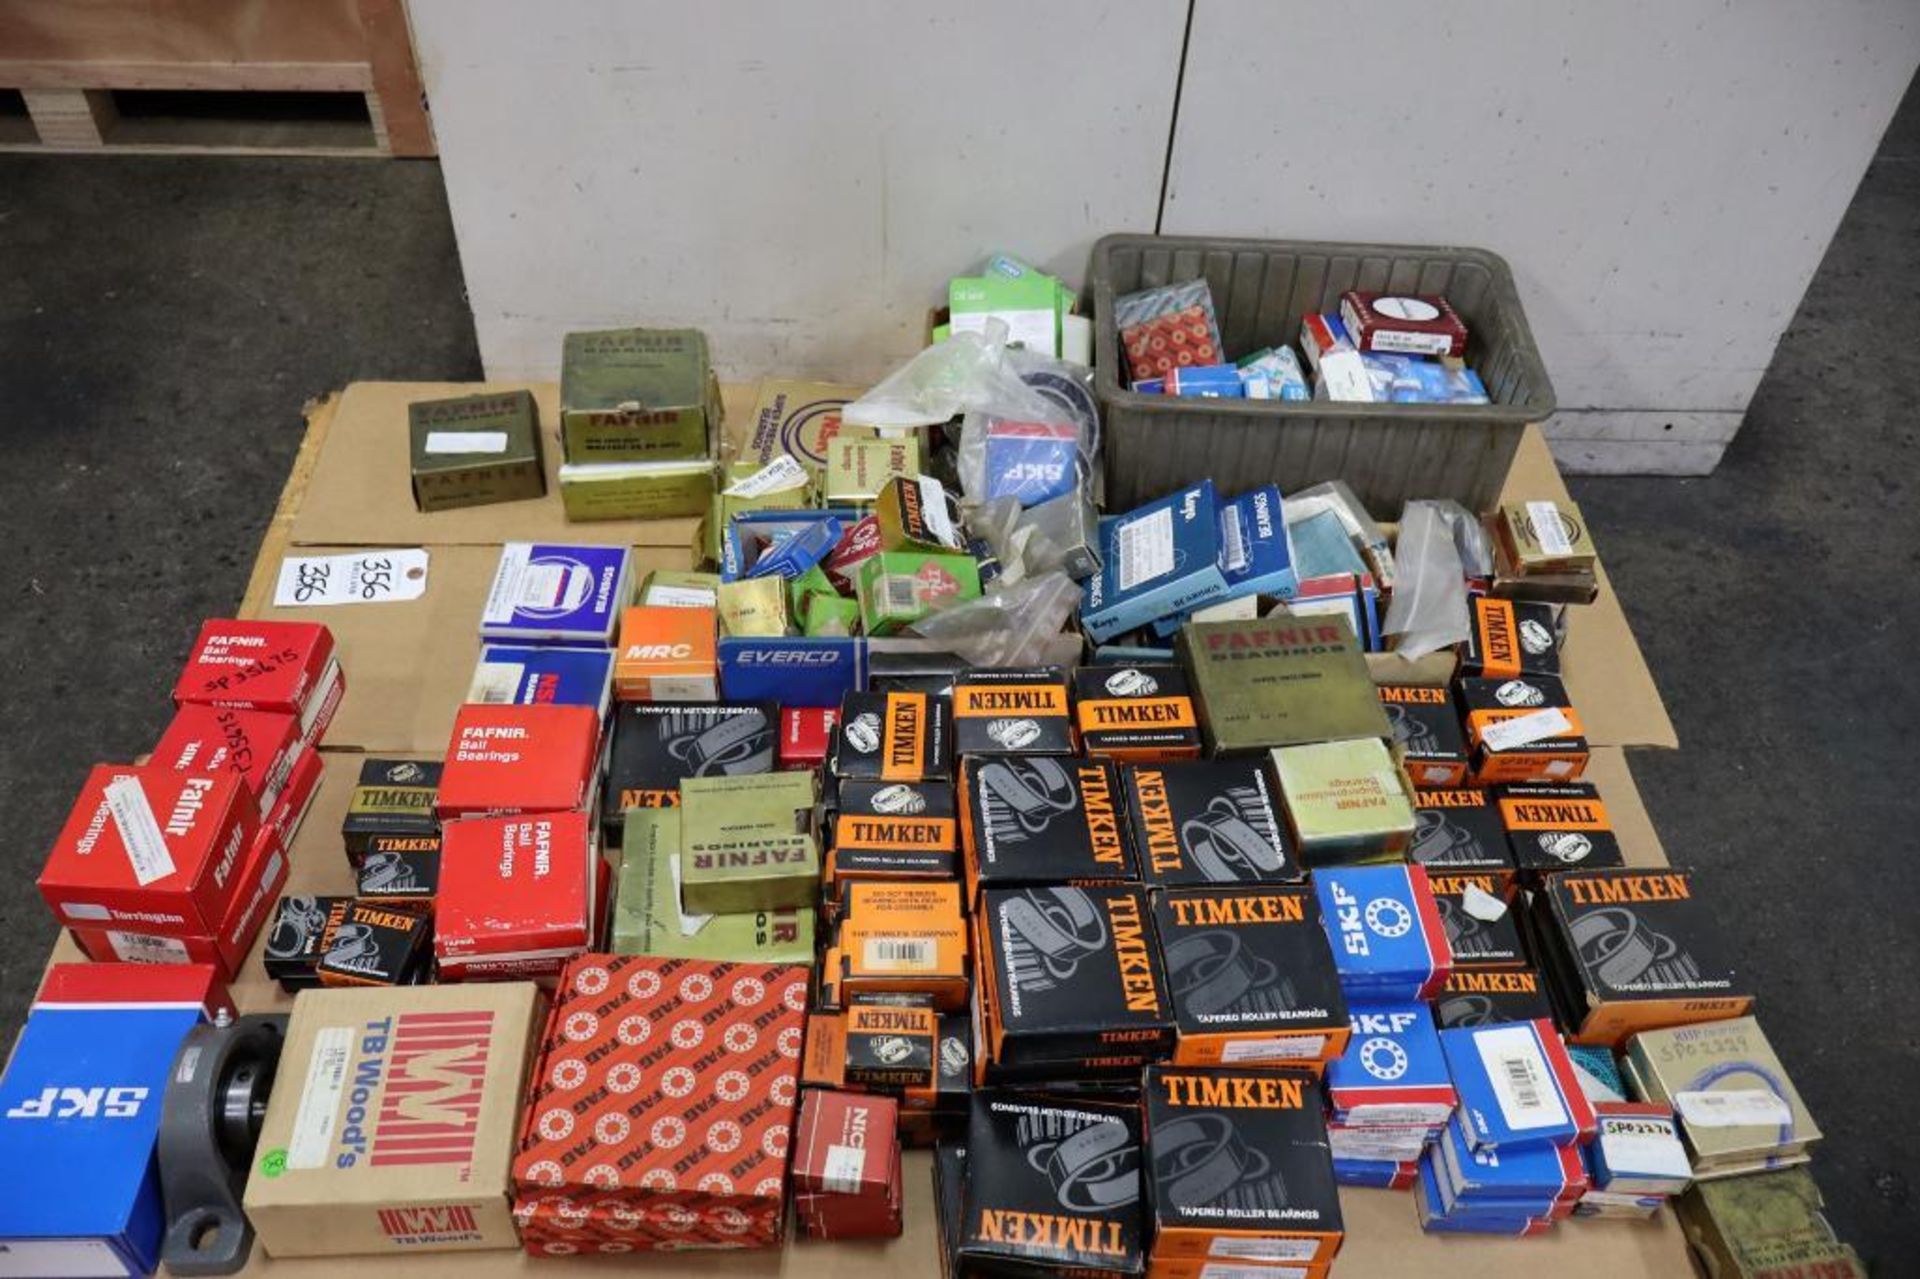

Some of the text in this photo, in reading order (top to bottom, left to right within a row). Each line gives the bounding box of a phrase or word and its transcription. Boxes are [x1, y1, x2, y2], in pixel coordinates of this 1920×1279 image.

[760, 421, 779, 463] PRECISIO
[1004, 463, 1064, 481] SKF
[904, 481, 922, 538] TIMKEN
[296, 563, 330, 601] 356
[362, 558, 392, 599] 356
[208, 636, 266, 648] FAFNIR
[1207, 626, 1340, 649] FAFNIR
[1485, 606, 1512, 663] TIMKEN
[625, 644, 692, 659] MRC
[737, 651, 840, 663] EVERCO
[536, 674, 559, 705] NS
[969, 691, 1056, 710] TIMKEN
[1377, 687, 1446, 704] IMKEN
[1093, 703, 1181, 724] TIMKEN
[460, 740, 487, 750] Ball
[462, 727, 527, 739] FAFNIR
[892, 701, 917, 767] TIMKEN
[457, 751, 520, 762] Bearings
[165, 778, 214, 836] Fafnir
[361, 790, 437, 808] TIMKEN
[620, 789, 681, 809] KEN
[1414, 791, 1485, 808] IMKEN
[1078, 765, 1124, 864] TIMKEN
[1134, 770, 1183, 874] TIMKEN
[1515, 804, 1598, 823] TIMKEN
[377, 838, 441, 851] TIMKEN
[520, 823, 533, 846] Ball
[852, 823, 942, 843] TIMKEN
[214, 823, 243, 889] Fafnir
[501, 823, 518, 878] Bearings
[535, 821, 551, 877] FAFNIR
[694, 850, 807, 869] FAFNIR
[1564, 874, 1691, 904] TIMKEN
[111, 909, 184, 924] Torrington
[352, 907, 416, 931] TIMKEN
[1169, 895, 1304, 926] TIMKEN
[1330, 881, 1370, 956] SKF
[1106, 894, 1160, 1012] TIMKEN
[1445, 972, 1538, 993] TIMKEN
[597, 992, 632, 1018] FAG
[649, 996, 683, 1022] FAG
[702, 999, 735, 1026] FAG
[755, 1003, 787, 1030] FAG
[1683, 1000, 1737, 1011] TIMKEN
[857, 1012, 928, 1031] TIMKEN
[1101, 1030, 1160, 1042] TIMKEN
[585, 1037, 620, 1065] FAG
[640, 1041, 674, 1069] FAG
[693, 1045, 727, 1073] FAG
[747, 1049, 781, 1077] FAG
[1084, 1056, 1144, 1067] TIMKEN
[7, 1087, 150, 1118] SKF
[337, 1016, 392, 1169] TB Wood's
[574, 1085, 609, 1115] FAG
[628, 1090, 664, 1118] FAG
[1162, 1076, 1303, 1109] TIMKEN
[683, 1093, 718, 1122] FAG
[739, 1098, 773, 1126] FAG
[852, 1107, 869, 1149] NIC
[560, 1137, 597, 1167] FAG
[617, 1141, 655, 1171] FAG
[674, 1144, 711, 1175] FAG
[730, 1149, 766, 1178] FAG
[1180, 1206, 1320, 1220] TAPERED ROLLER BEARINGS
[978, 1209, 1127, 1256] TIMKEN
